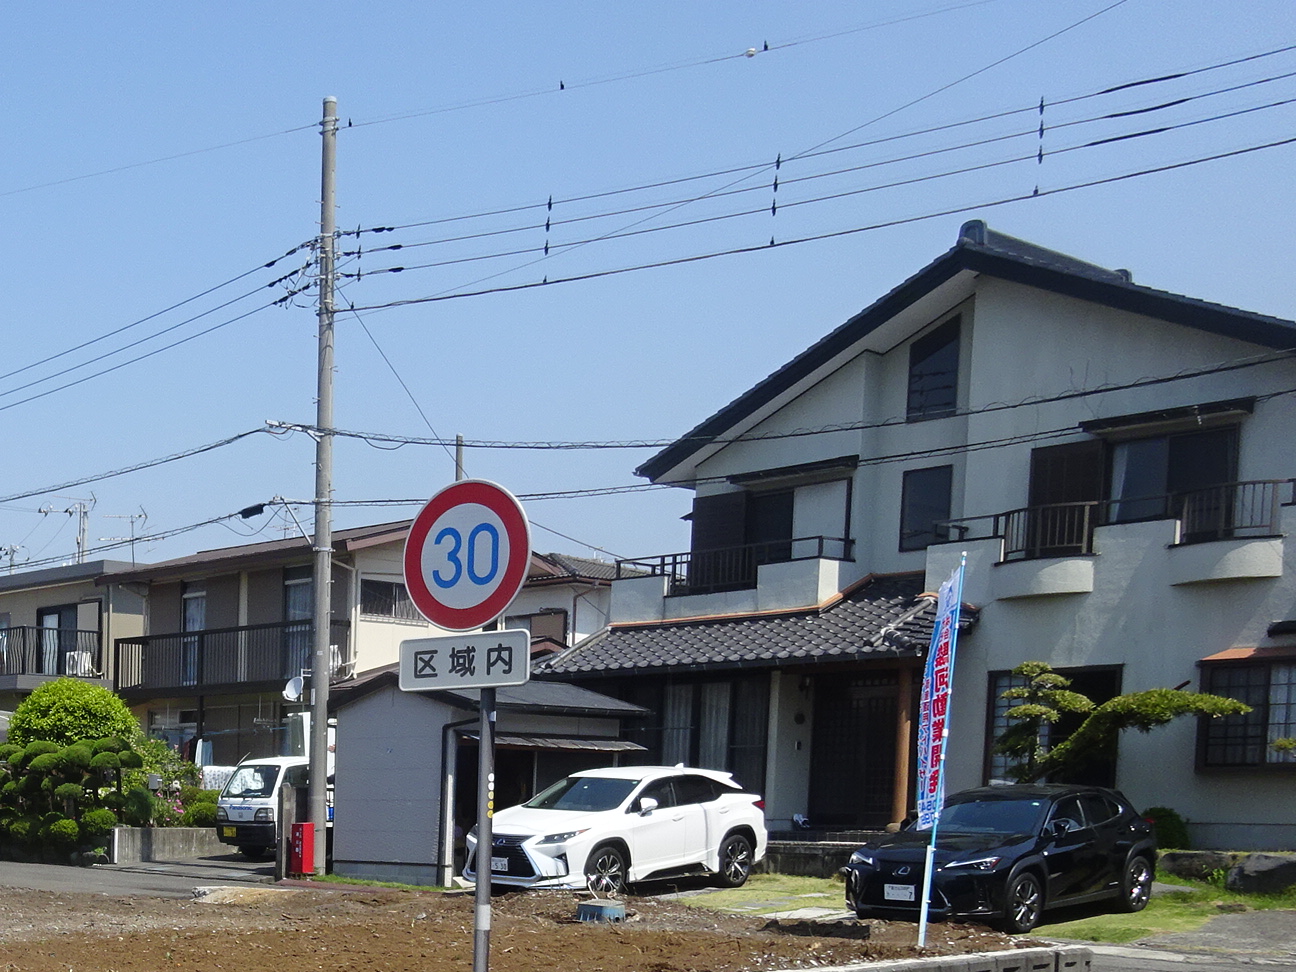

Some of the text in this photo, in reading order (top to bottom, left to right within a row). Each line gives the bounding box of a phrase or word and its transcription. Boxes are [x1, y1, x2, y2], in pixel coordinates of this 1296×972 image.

[432, 522, 500, 589] 30
[413, 643, 513, 679] 区域内
